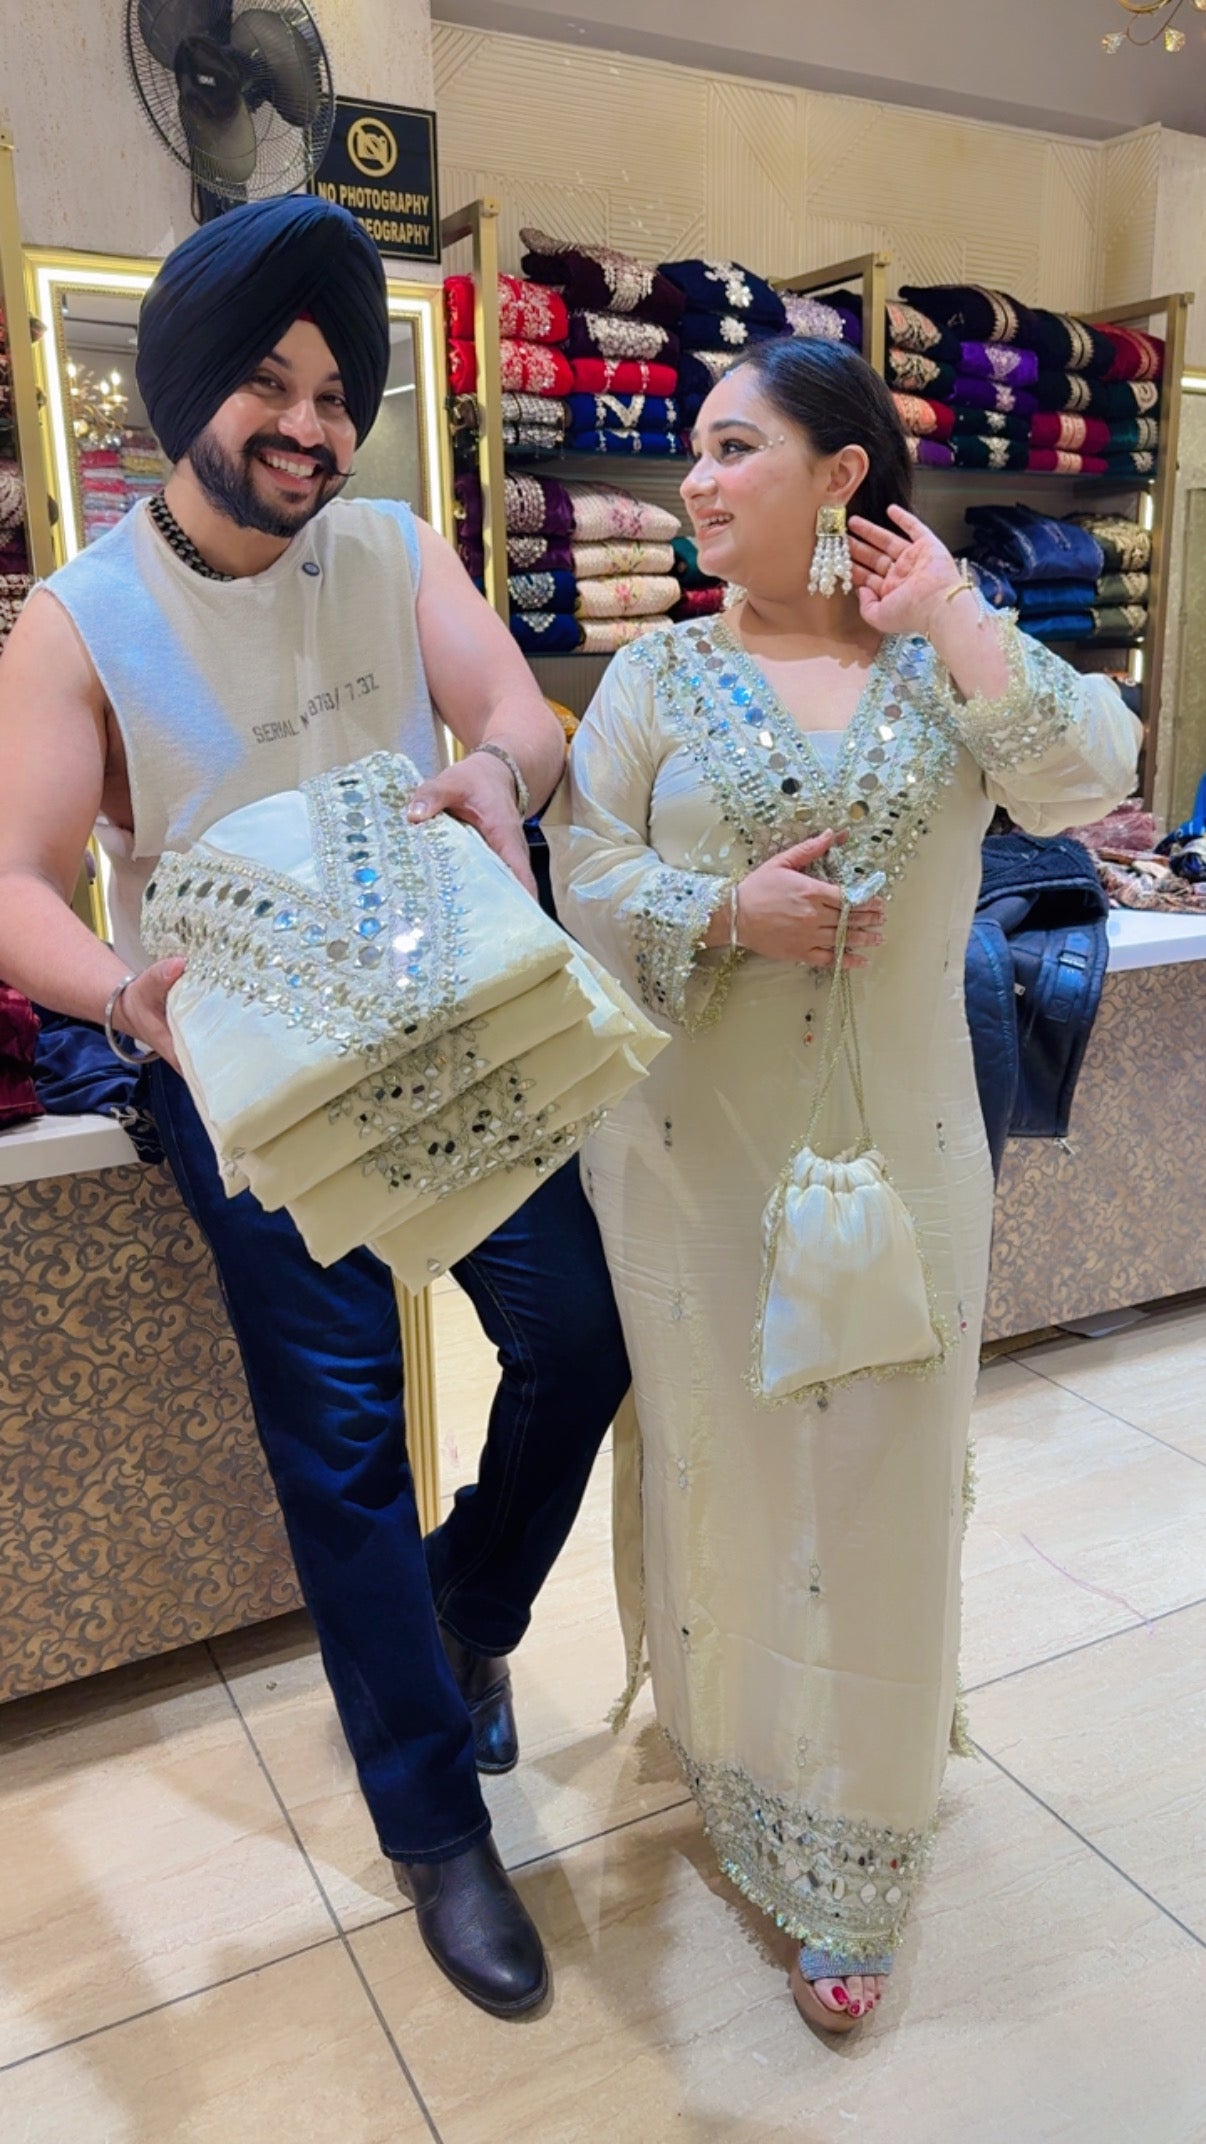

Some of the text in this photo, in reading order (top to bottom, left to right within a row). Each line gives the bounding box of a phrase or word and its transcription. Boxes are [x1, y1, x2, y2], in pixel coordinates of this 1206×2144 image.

[317, 182, 429, 216] NO PHOTOGRAPHY
[252, 720, 299, 744] SERIAL
